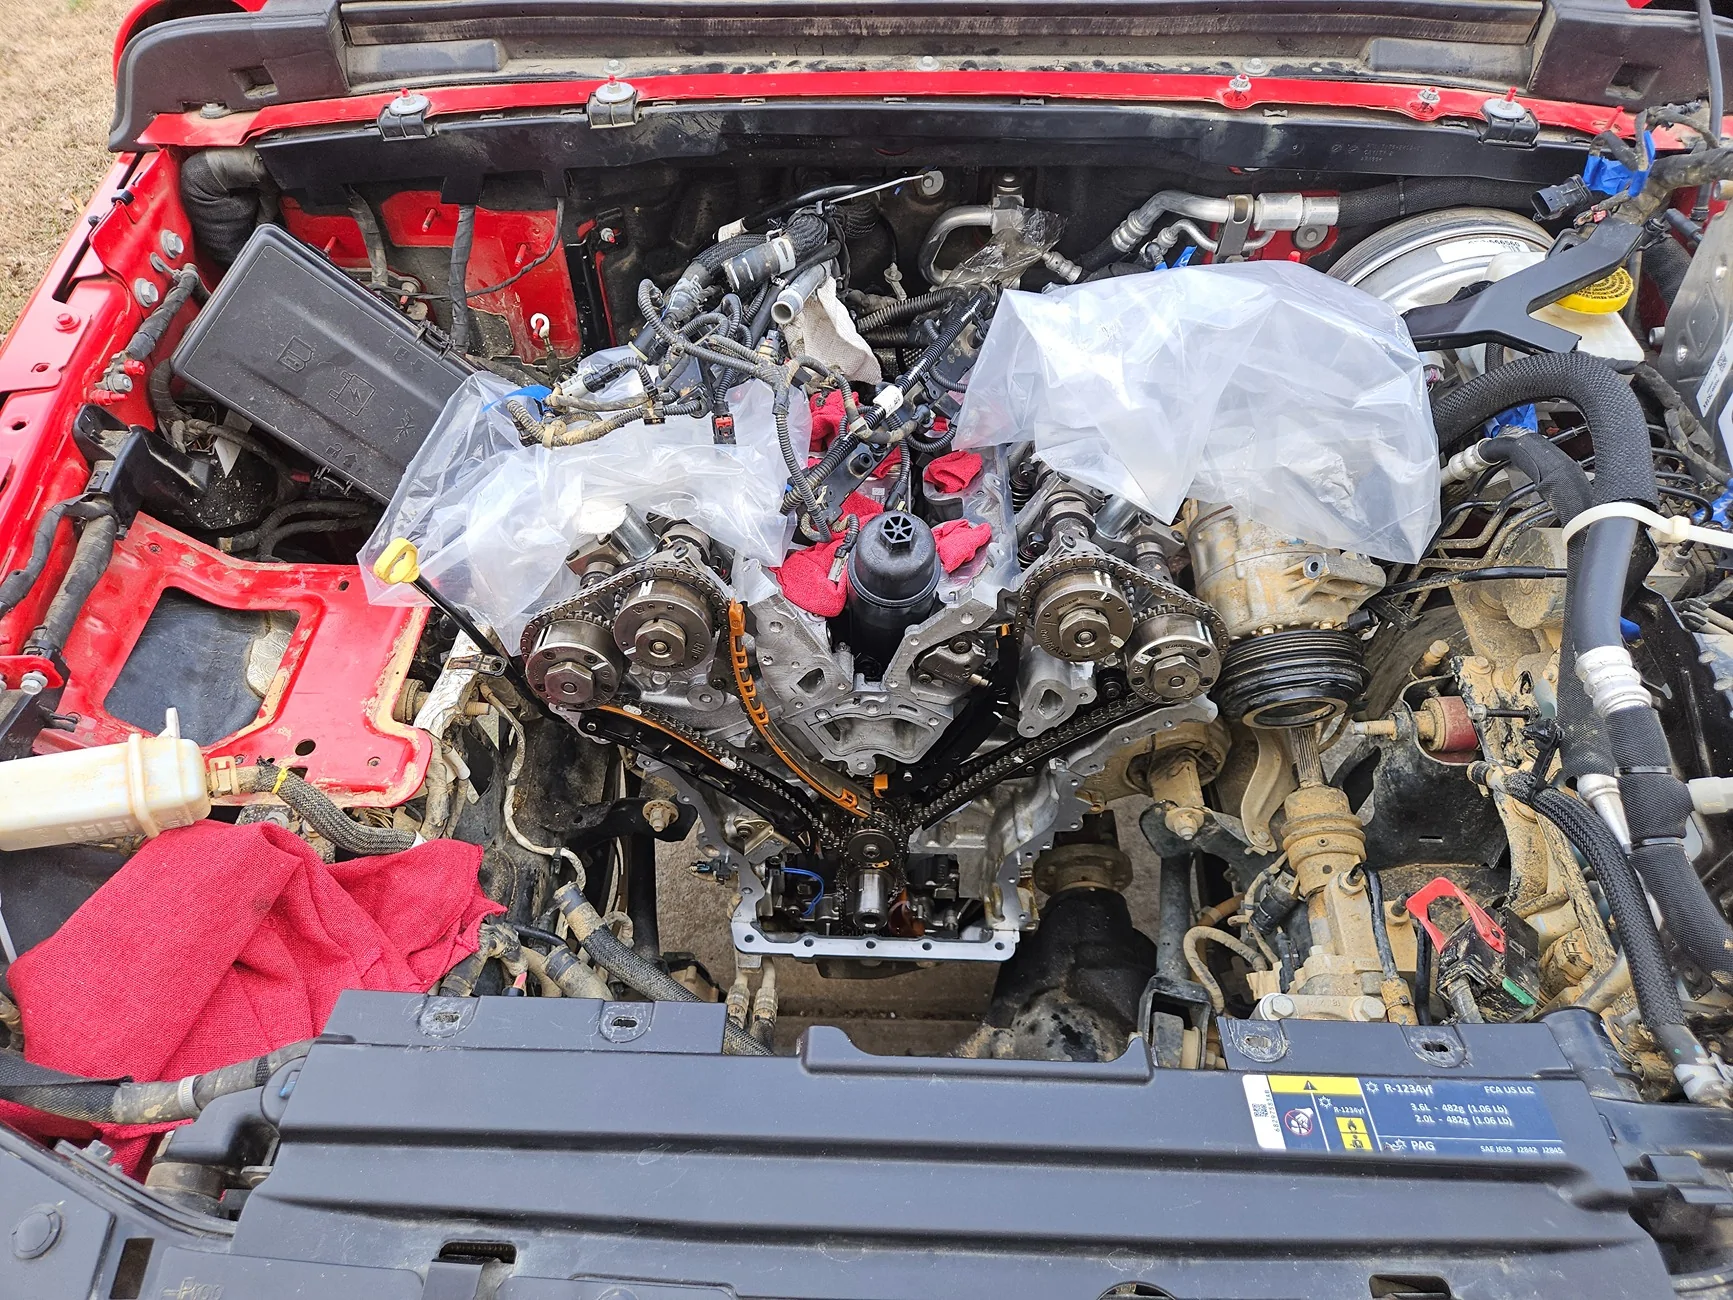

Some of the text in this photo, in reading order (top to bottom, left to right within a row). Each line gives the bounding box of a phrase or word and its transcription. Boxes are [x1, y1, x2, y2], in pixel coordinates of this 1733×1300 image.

[1384, 1083, 1434, 1096] R-1234yf
[1484, 1086, 1535, 1094] FCA US LLC
[1333, 1106, 1365, 1115] R-1234yf
[1410, 1102, 1431, 1111] 3.6L
[1441, 1103, 1466, 1114] 482g
[1467, 1104, 1492, 1114] (1.06
[1492, 1104, 1508, 1115] Lb)
[1414, 1114, 1436, 1123] 2.0L
[1446, 1116, 1470, 1125] 482g
[1472, 1116, 1496, 1126] (1.06
[1498, 1116, 1514, 1127] Lb)
[1410, 1140, 1436, 1151] PAG
[1480, 1145, 1495, 1153] SAE
